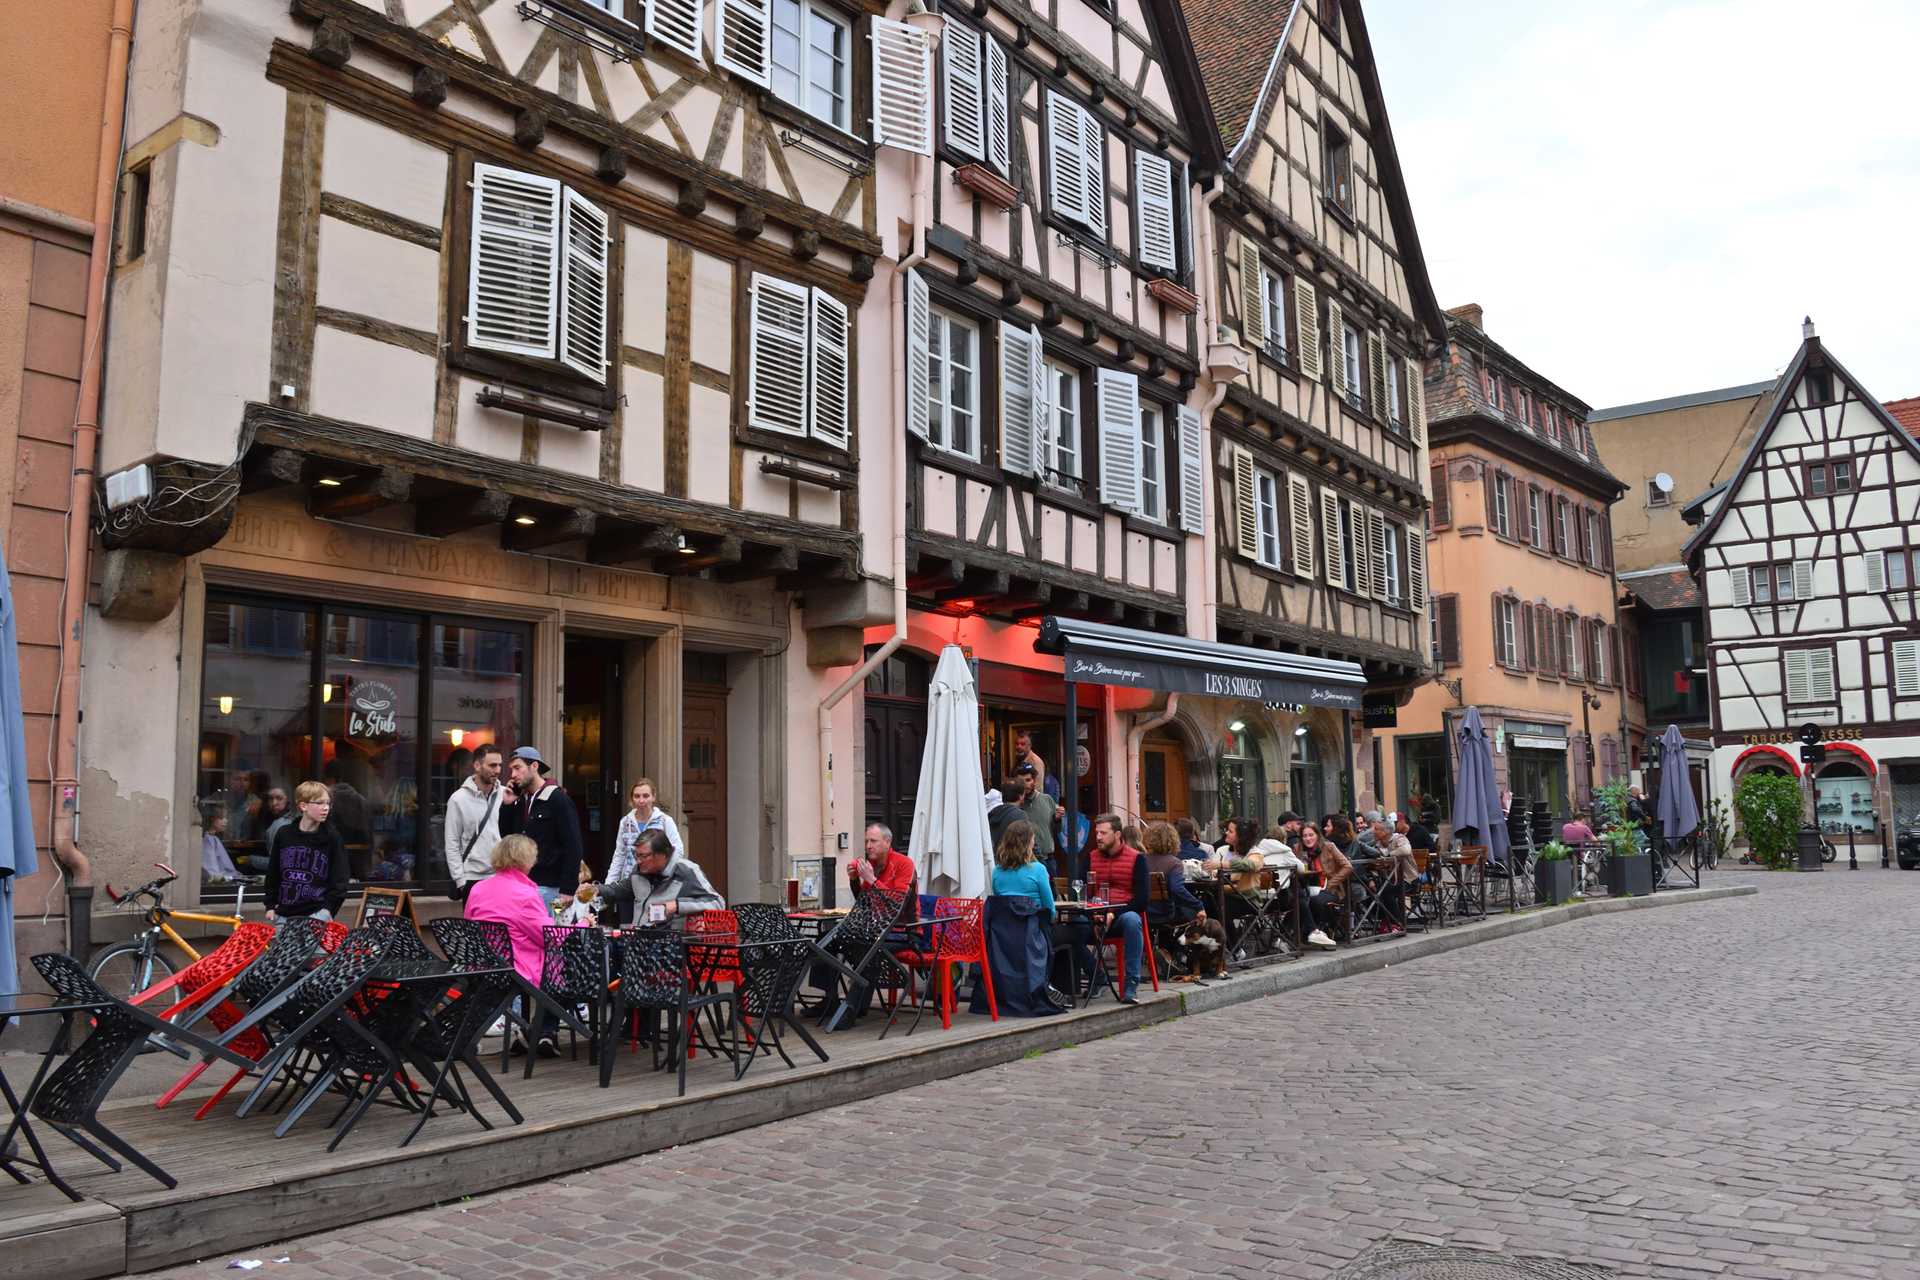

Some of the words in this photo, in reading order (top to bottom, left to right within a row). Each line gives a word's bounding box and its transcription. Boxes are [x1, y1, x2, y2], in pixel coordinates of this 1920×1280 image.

[232, 511, 299, 551] BROT
[325, 529, 346, 559] &
[1206, 673, 1223, 694] LES
[1223, 676, 1230, 695] 3
[1231, 676, 1262, 698] SINGES
[349, 712, 364, 736] La
[364, 710, 397, 738] Stub
[1743, 732, 1794, 746] TABACS
[287, 871, 308, 881] XXL
